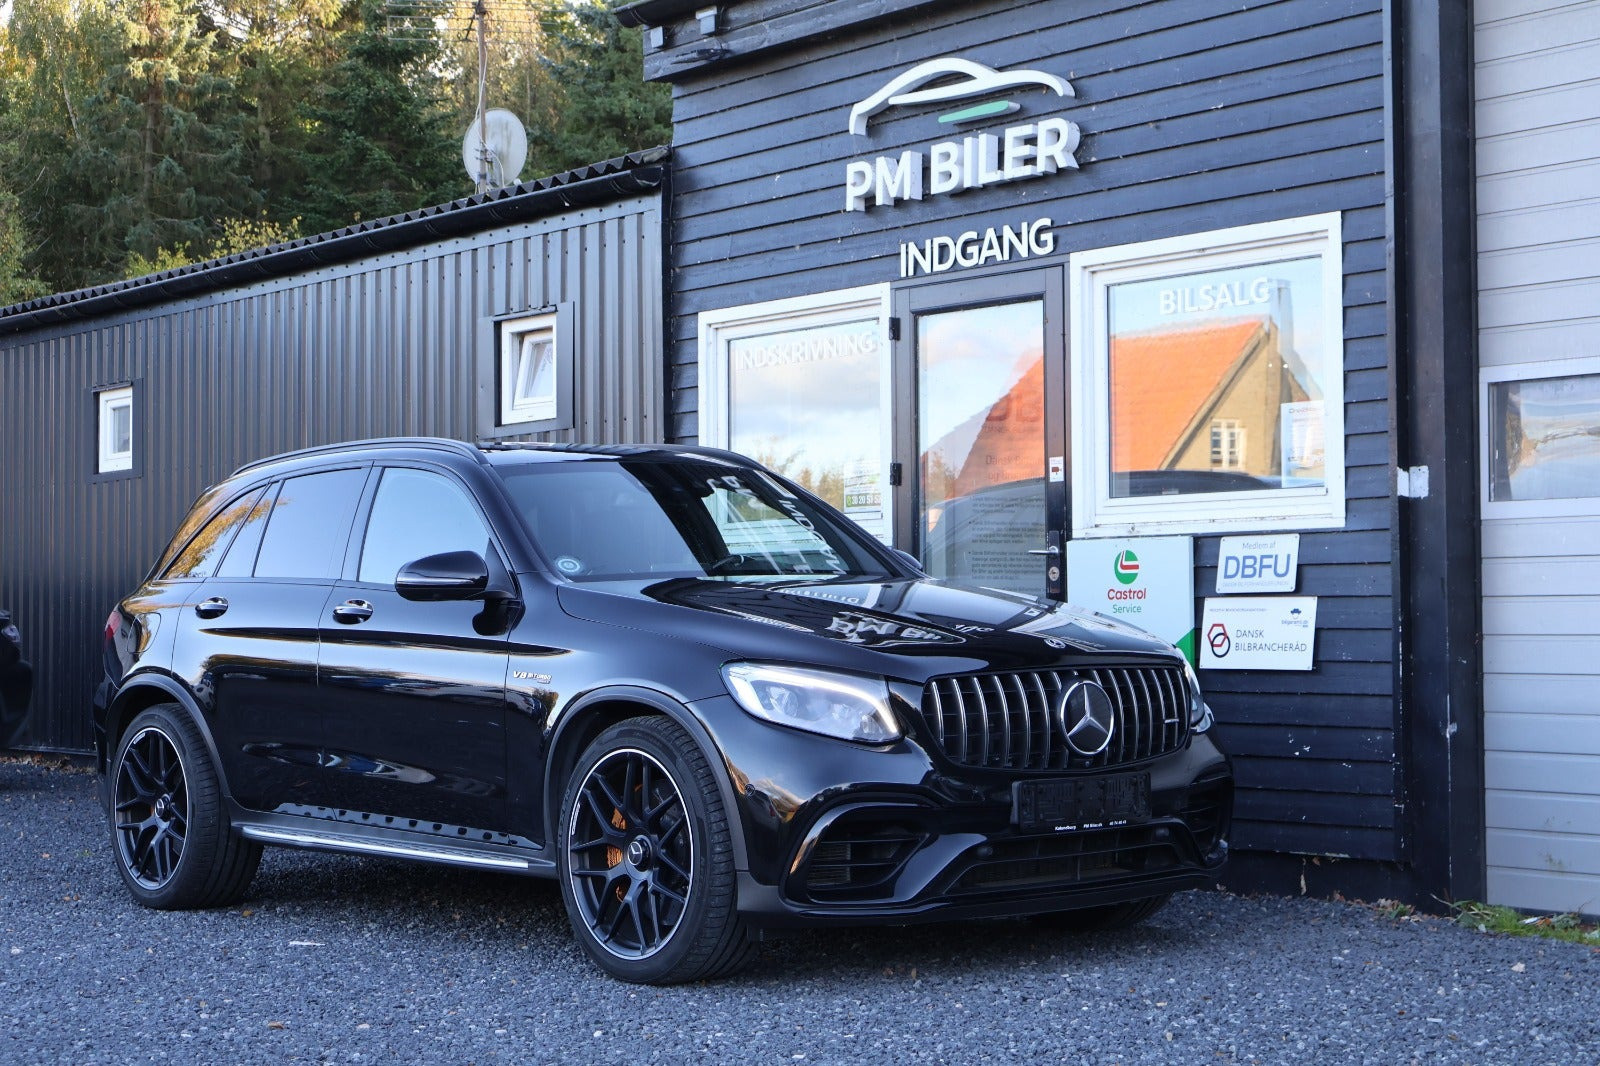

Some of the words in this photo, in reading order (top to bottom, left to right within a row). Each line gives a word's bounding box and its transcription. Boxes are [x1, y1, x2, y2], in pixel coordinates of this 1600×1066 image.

[846, 151, 922, 212] PM
[931, 117, 1080, 195] BILER
[900, 217, 1054, 277] INDGANG
[1159, 276, 1270, 315] BILSALG
[734, 330, 877, 370] INDSKRIVNING
[1242, 541, 1268, 550] Medlem
[1269, 540, 1276, 549] af
[1223, 553, 1291, 579] DBFU
[1107, 588, 1146, 600] Castrol
[1112, 604, 1142, 613] Service
[1235, 629, 1264, 639] DANSK
[1235, 641, 1307, 652] BILBRANCHERÅD
[513, 670, 527, 679] V8
